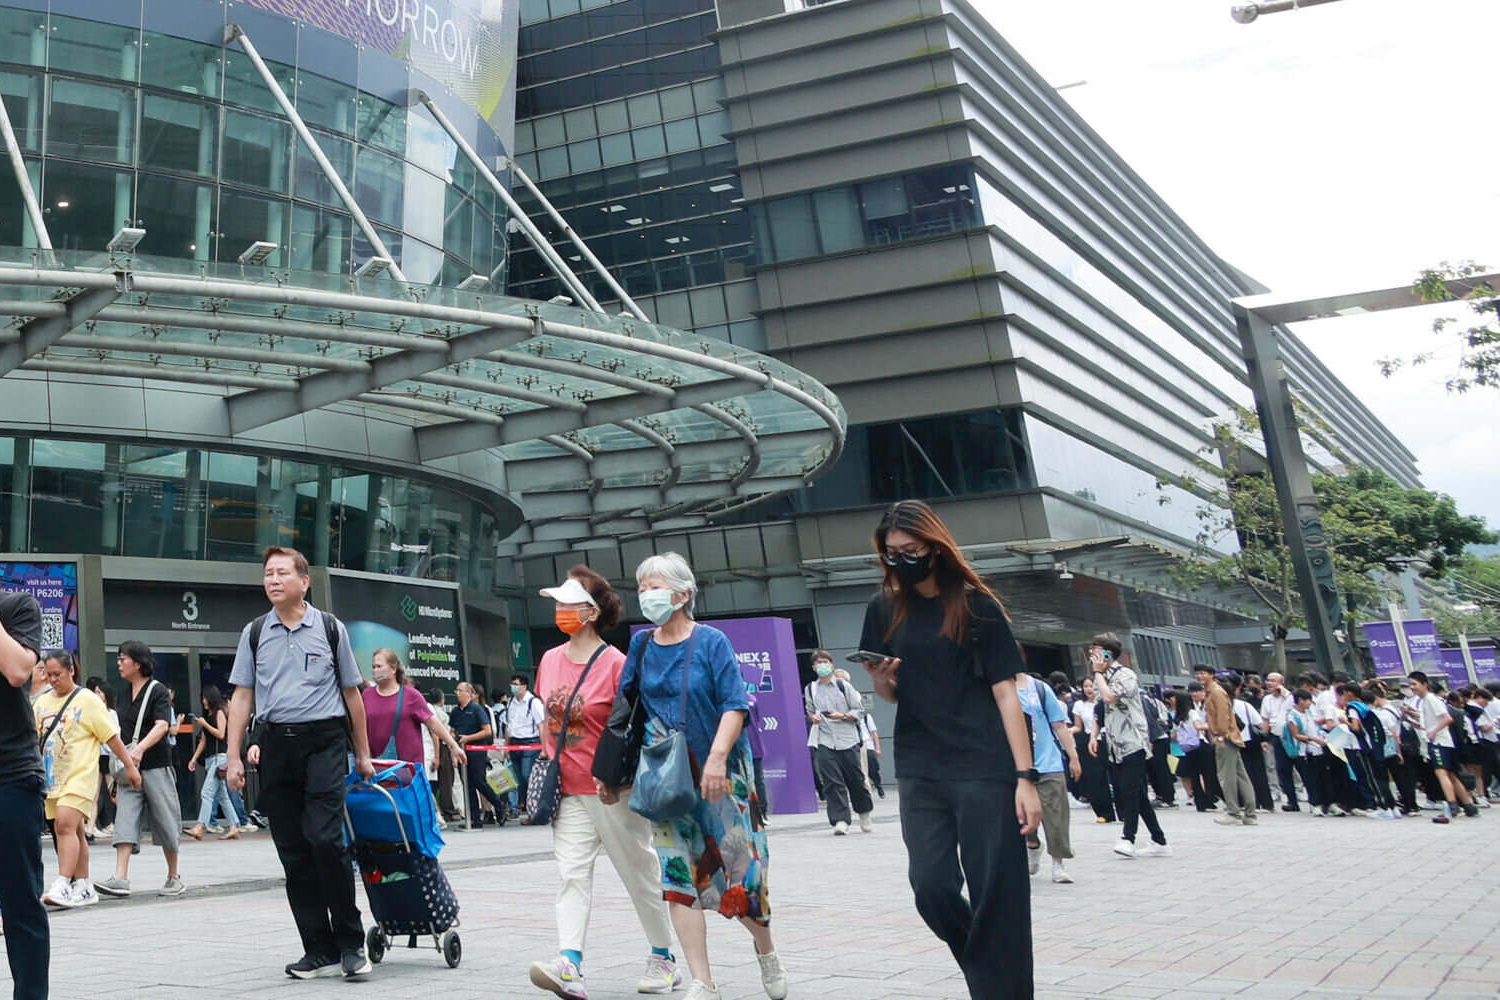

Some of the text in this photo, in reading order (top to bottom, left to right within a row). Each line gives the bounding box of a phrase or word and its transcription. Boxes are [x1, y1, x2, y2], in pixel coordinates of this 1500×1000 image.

[48, 578, 62, 586] here
[37, 588, 64, 598] P6206
[182, 591, 199, 621] 3
[171, 621, 210, 630] North Entrance
[408, 632, 455, 648] Leading Supplier
[409, 649, 457, 663] of Polyimides for
[735, 651, 770, 663] NEX 2
[430, 666, 460, 681] Packaging
